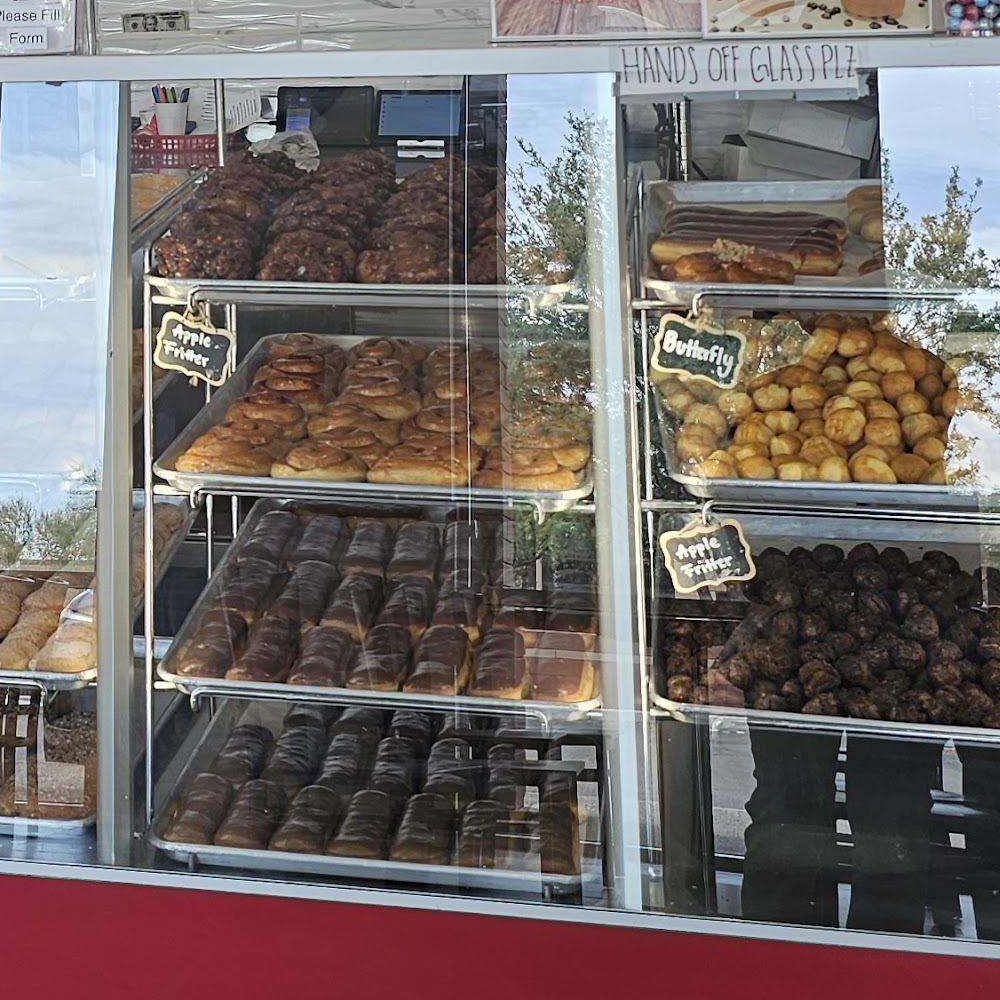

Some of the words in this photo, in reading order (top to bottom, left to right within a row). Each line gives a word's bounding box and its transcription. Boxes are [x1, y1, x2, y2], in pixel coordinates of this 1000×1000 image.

[41, 8, 60, 22] Fill
[9, 31, 44, 45] Form
[621, 46, 698, 84] HANDS
[708, 45, 740, 82] OFF
[750, 44, 816, 83] GLASS
[821, 44, 857, 80] PLZ
[173, 322, 212, 348] Apple
[163, 339, 209, 368] Fritter
[662, 329, 735, 379] Butterfly
[675, 535, 721, 560] Apple
[680, 553, 734, 578] Fritter
